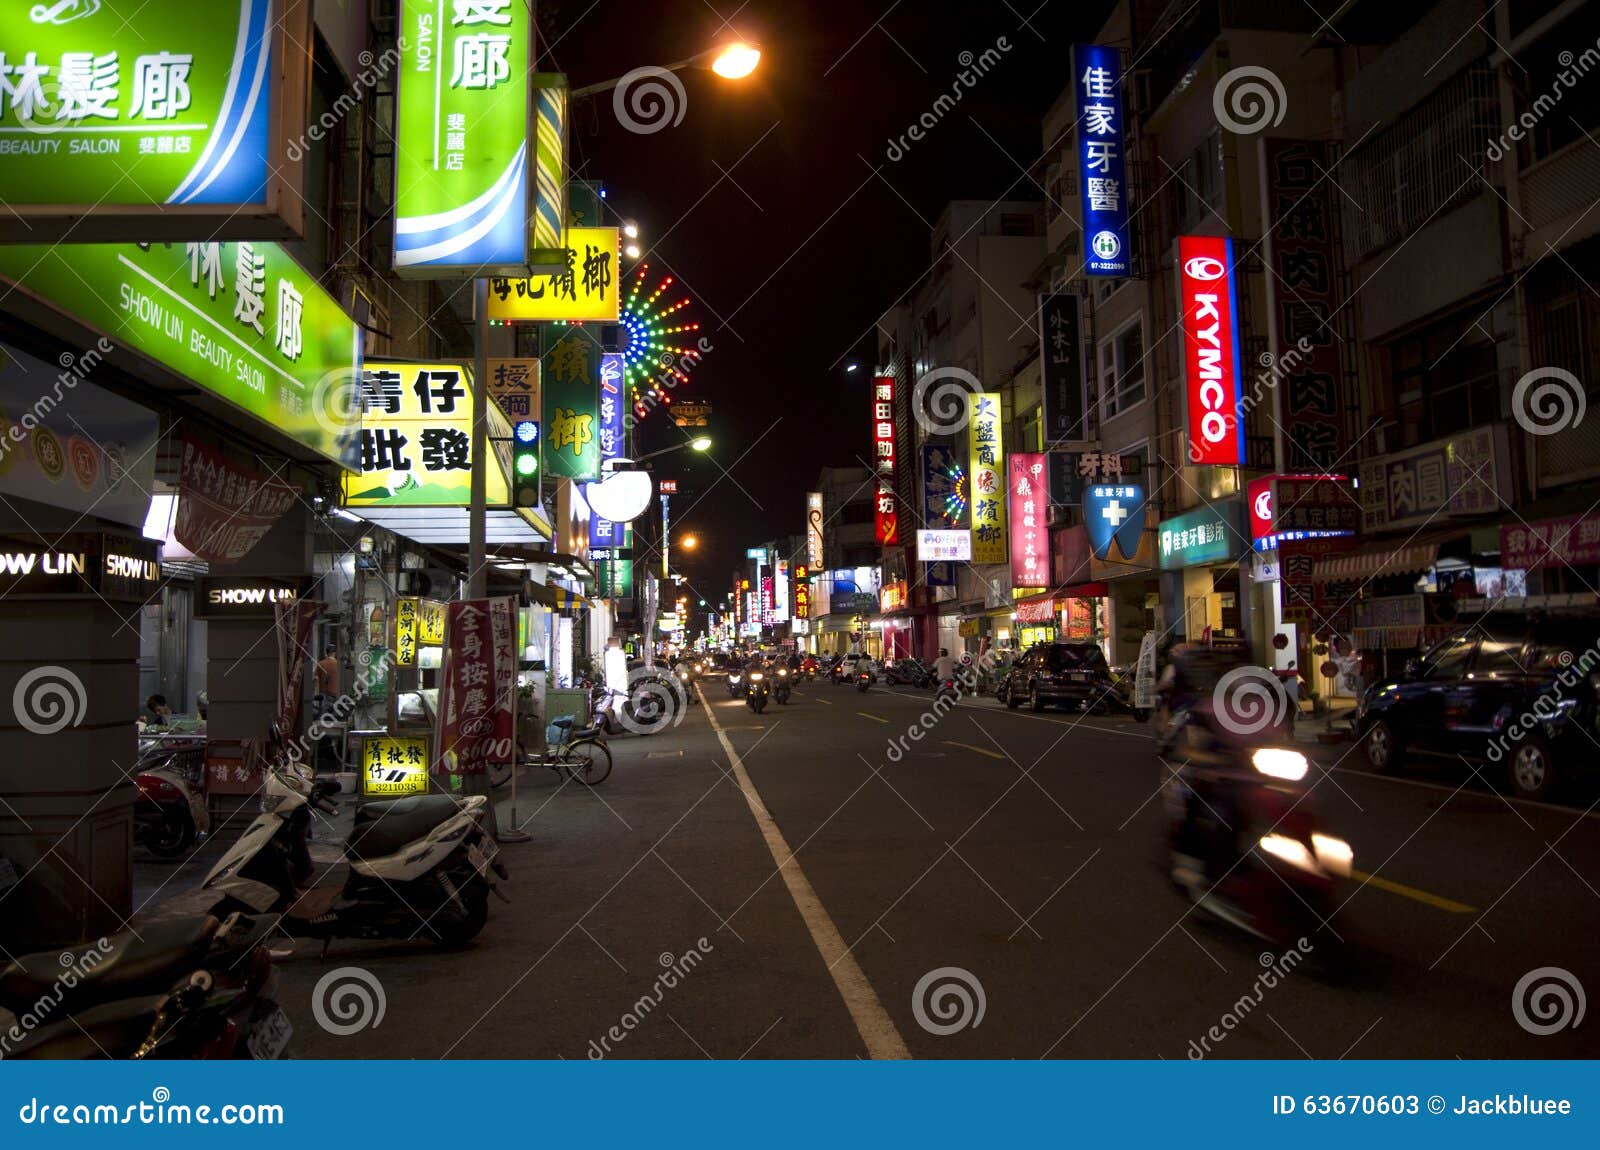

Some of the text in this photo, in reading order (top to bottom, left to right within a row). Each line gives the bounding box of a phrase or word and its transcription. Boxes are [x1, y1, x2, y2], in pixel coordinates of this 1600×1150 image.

[417, 14, 433, 72] SALON
[69, 139, 120, 154] SALON
[1082, 66, 1120, 212] 佳家牙醫
[120, 282, 266, 395] SHOW LIN BEAUTY SALON
[1195, 294, 1227, 443] KYMCO
[548, 336, 593, 457] 檳榔
[362, 427, 472, 472] 批發
[1080, 453, 1122, 477] 牙科
[1094, 487, 1136, 498] 佳家牙醫
[1172, 520, 1225, 551] 佳家牙醫診所
[43, 553, 85, 574] LIN
[107, 554, 161, 582] SHOW LIN
[209, 589, 264, 604] SHOW
[456, 604, 489, 717] 全身按摩
[375, 783, 417, 792] 3211038
